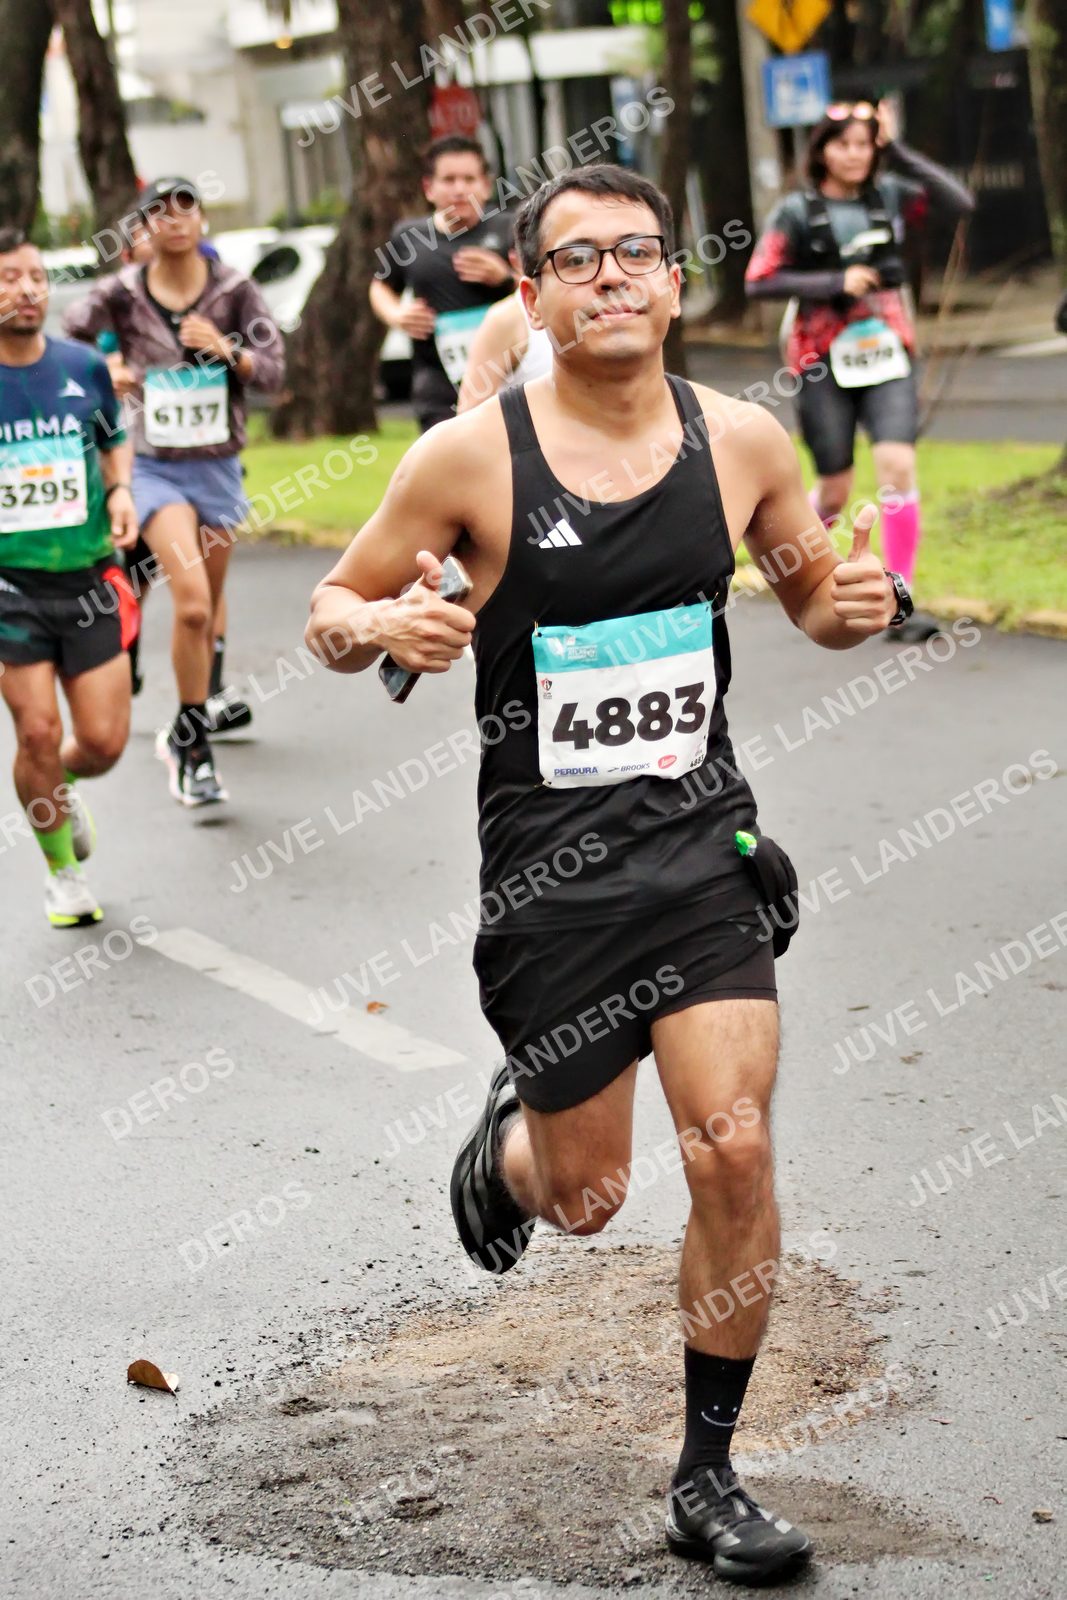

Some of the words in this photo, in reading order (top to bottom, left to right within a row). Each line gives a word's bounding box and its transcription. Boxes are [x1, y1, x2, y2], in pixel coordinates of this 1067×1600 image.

[154, 401, 219, 427] 6137
[0, 479, 78, 508] 3295
[552, 682, 706, 750] 4883
[554, 766, 598, 776] PERDURA
[620, 762, 650, 772] BROOKS
